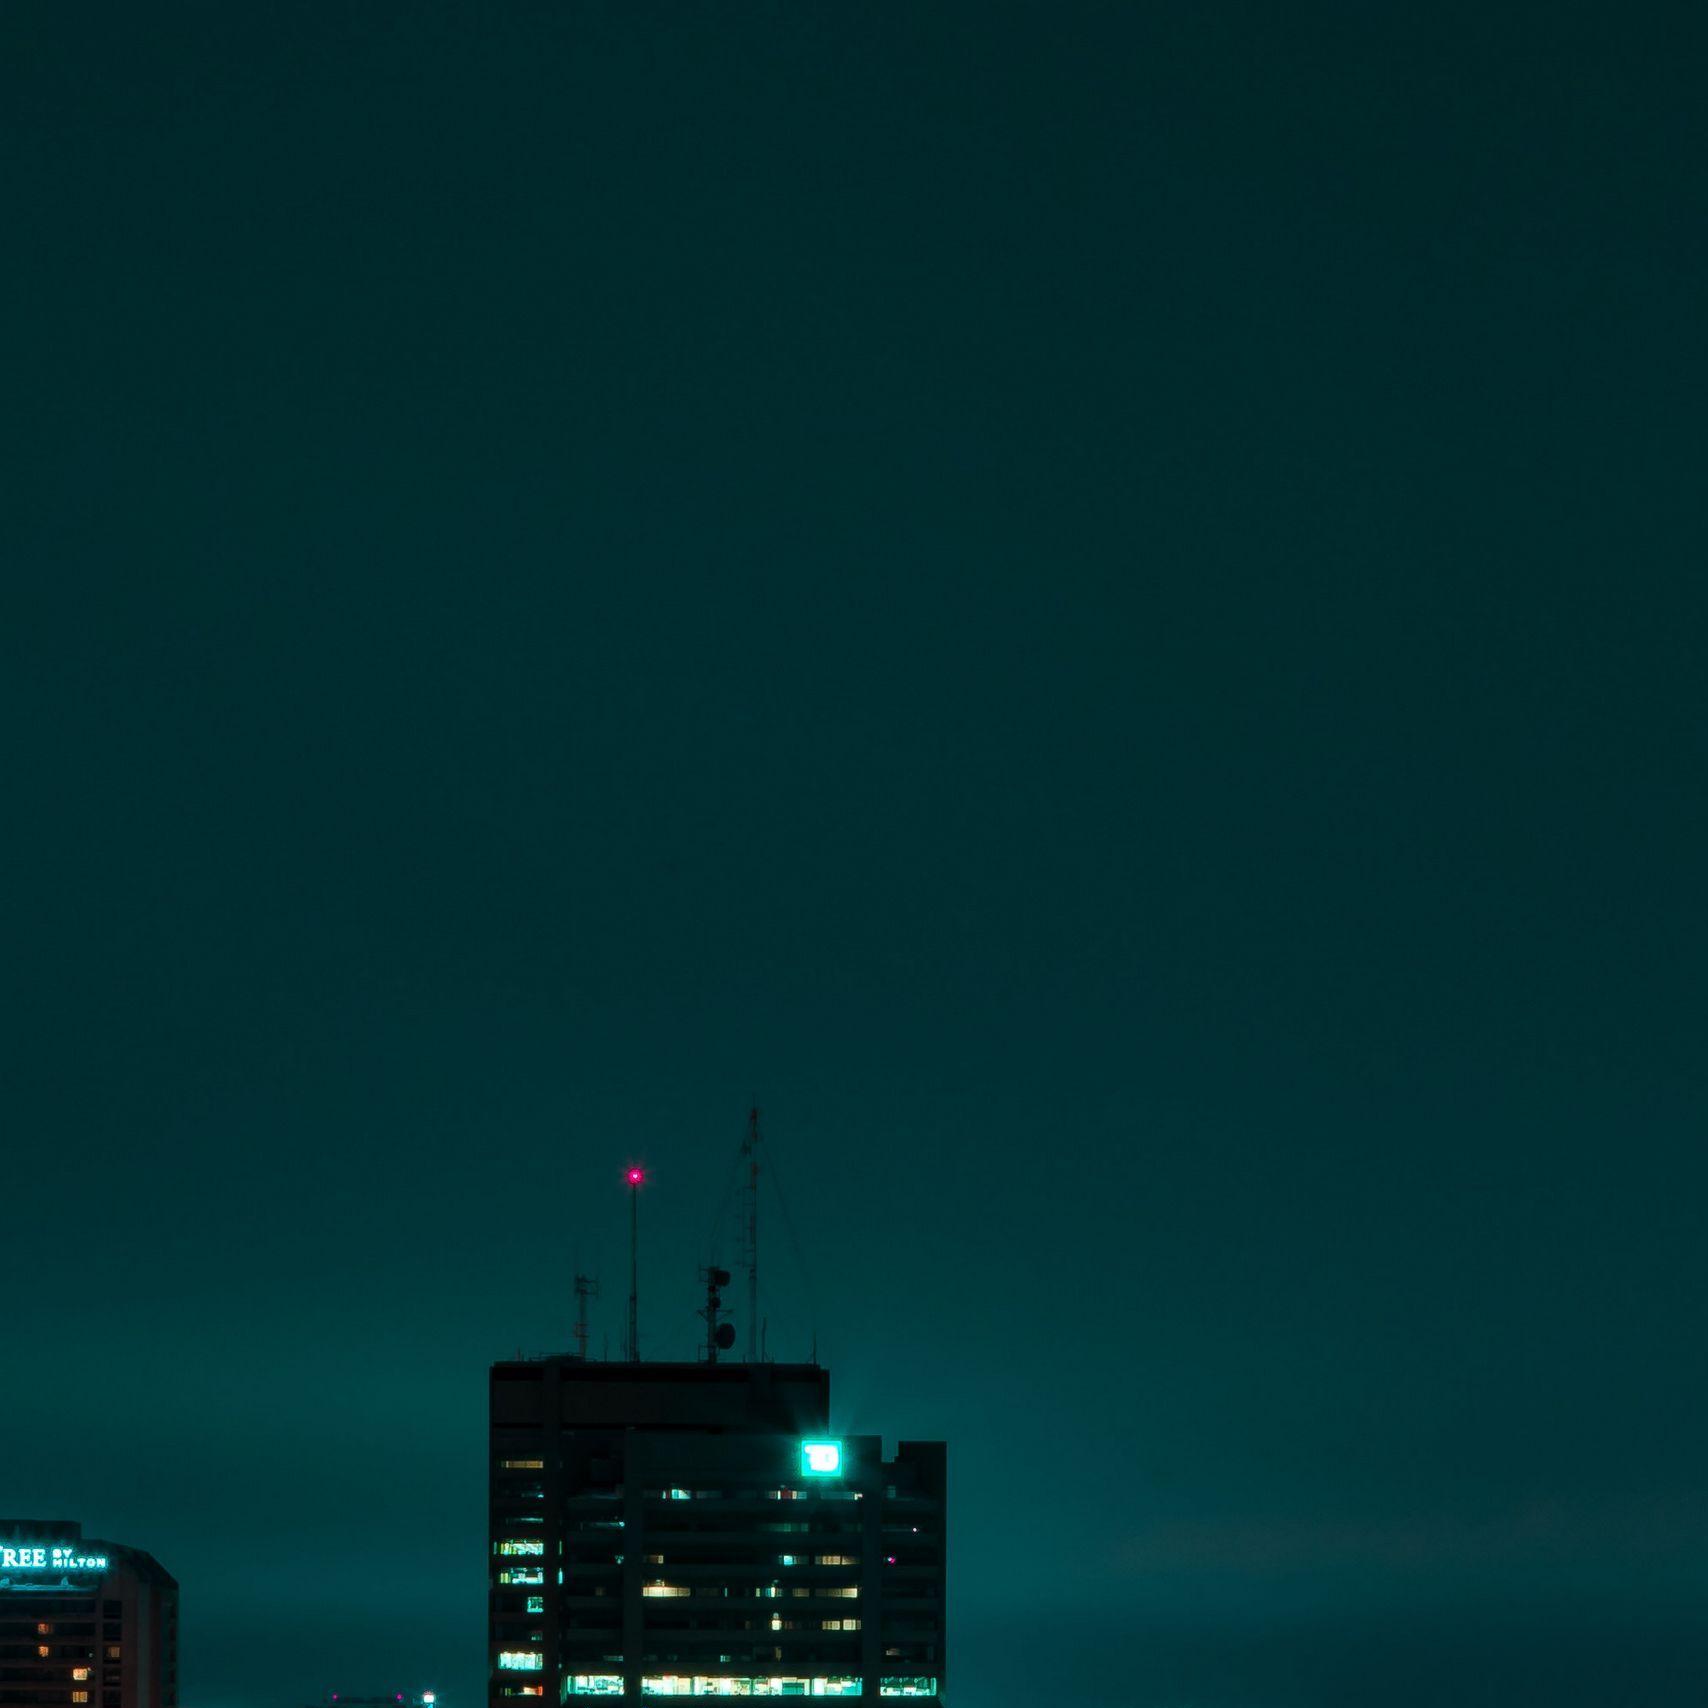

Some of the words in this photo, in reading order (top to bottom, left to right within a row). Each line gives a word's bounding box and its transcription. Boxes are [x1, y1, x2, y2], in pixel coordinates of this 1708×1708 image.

[0, 1546, 47, 1567] REE
[52, 1548, 73, 1558] BY
[52, 1558, 106, 1568] HILTON
